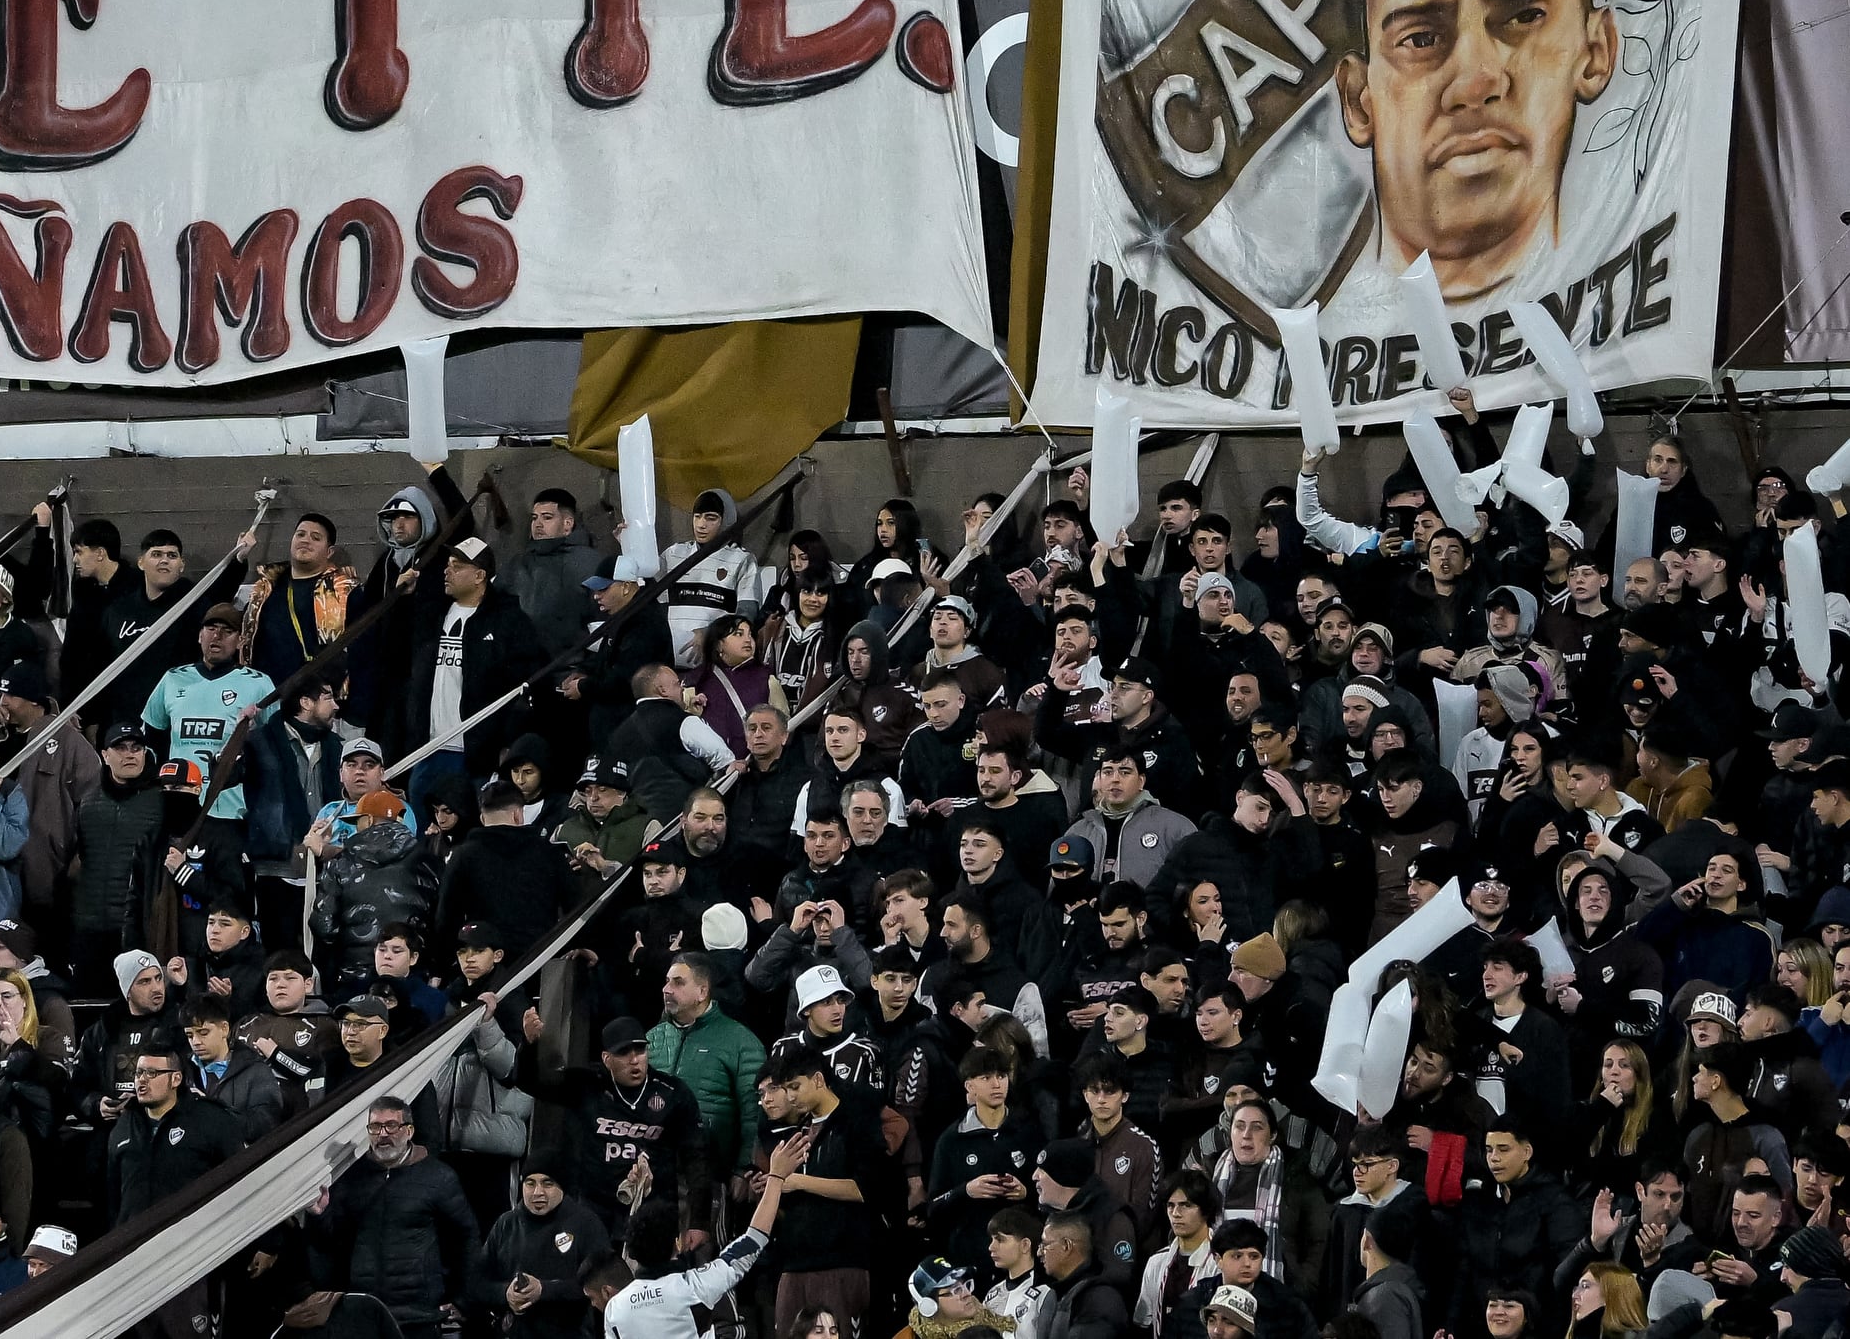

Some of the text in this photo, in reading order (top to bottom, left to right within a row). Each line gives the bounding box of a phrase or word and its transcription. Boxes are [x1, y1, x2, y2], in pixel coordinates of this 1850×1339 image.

[1085, 211, 1678, 410] NICO RESENTE
[184, 721, 221, 736] TRF
[129, 1032, 142, 1045] 10
[596, 1117, 664, 1140] ESCO
[605, 1142, 650, 1162] pa
[630, 1287, 663, 1304] CIVILE
